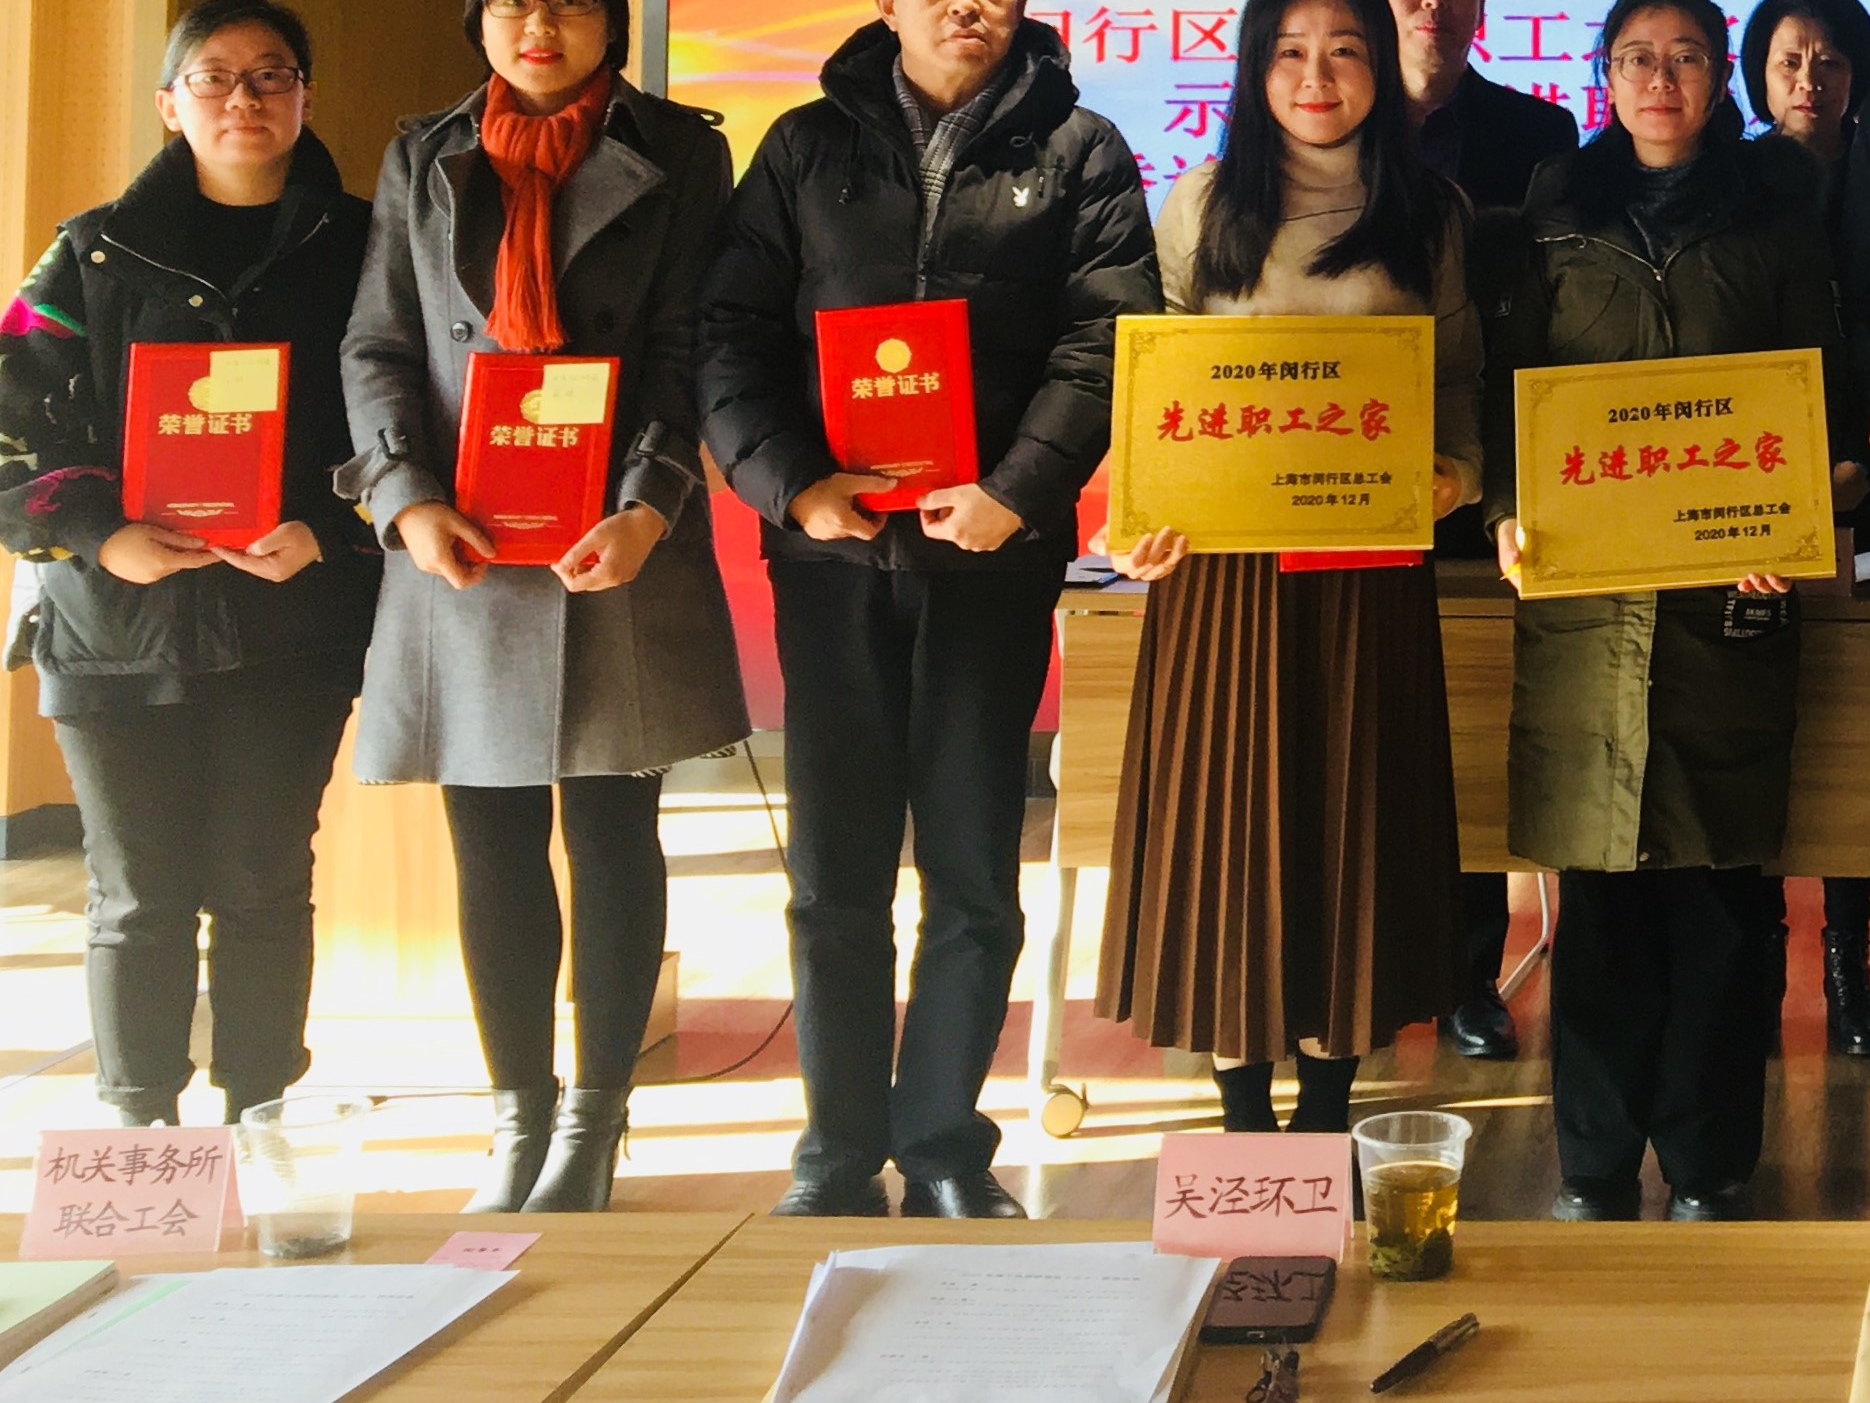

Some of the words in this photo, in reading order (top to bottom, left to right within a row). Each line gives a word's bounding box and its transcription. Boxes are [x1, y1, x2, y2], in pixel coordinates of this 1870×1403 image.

[1211, 361, 1341, 381] 2020年闵行区
[851, 372, 940, 399] 荣誉证书
[1157, 399, 1392, 441] 先进职工之家
[1608, 397, 1733, 423] 2020年闵行区
[158, 413, 253, 435] 荣誉证书
[489, 425, 580, 448] 荣誉证书
[1560, 431, 1788, 486] 先进职工之家
[1271, 472, 1392, 486] 上海市闵行区总工会
[1673, 502, 1791, 523] 上海市闵行区总工会
[44, 1144, 223, 1186] 机关事务所
[1164, 1174, 1337, 1219] 吴泾环卫
[53, 1199, 198, 1238] 联合工会
